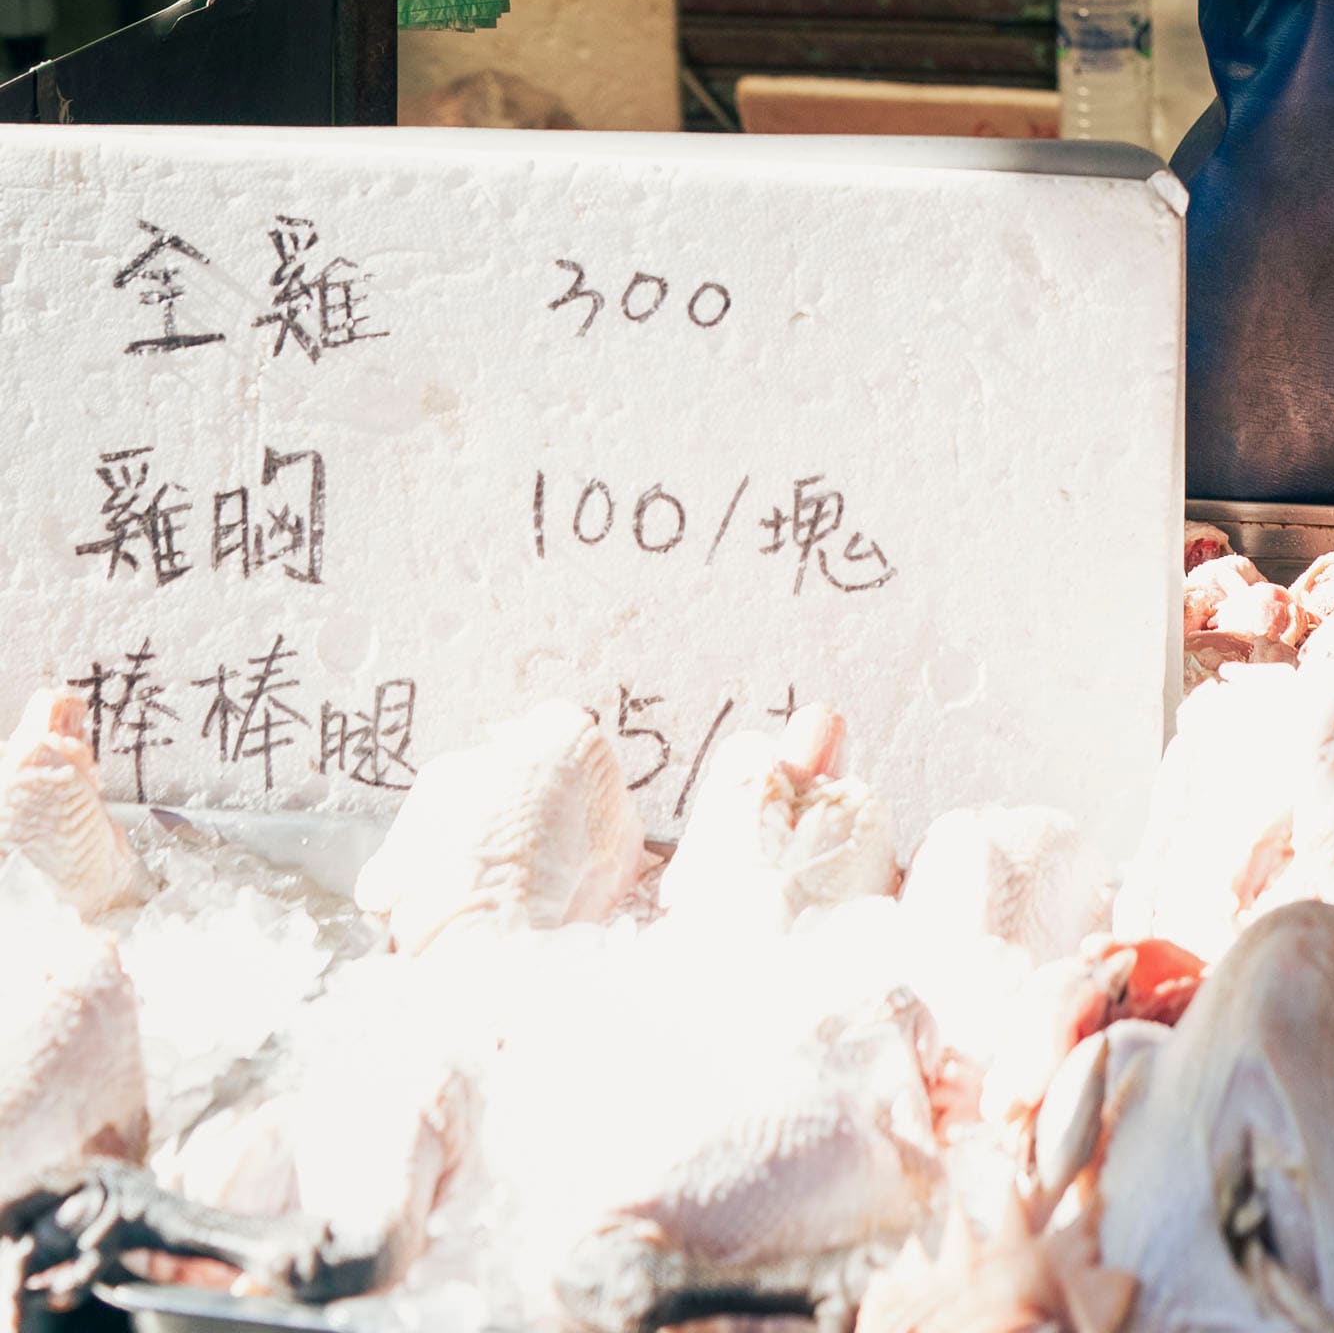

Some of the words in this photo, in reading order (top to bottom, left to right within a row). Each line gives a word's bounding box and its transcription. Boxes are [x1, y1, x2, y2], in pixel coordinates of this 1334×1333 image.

[113, 214, 390, 363] 全雞
[546, 259, 732, 337] 300
[532, 469, 898, 596] 100/塊
